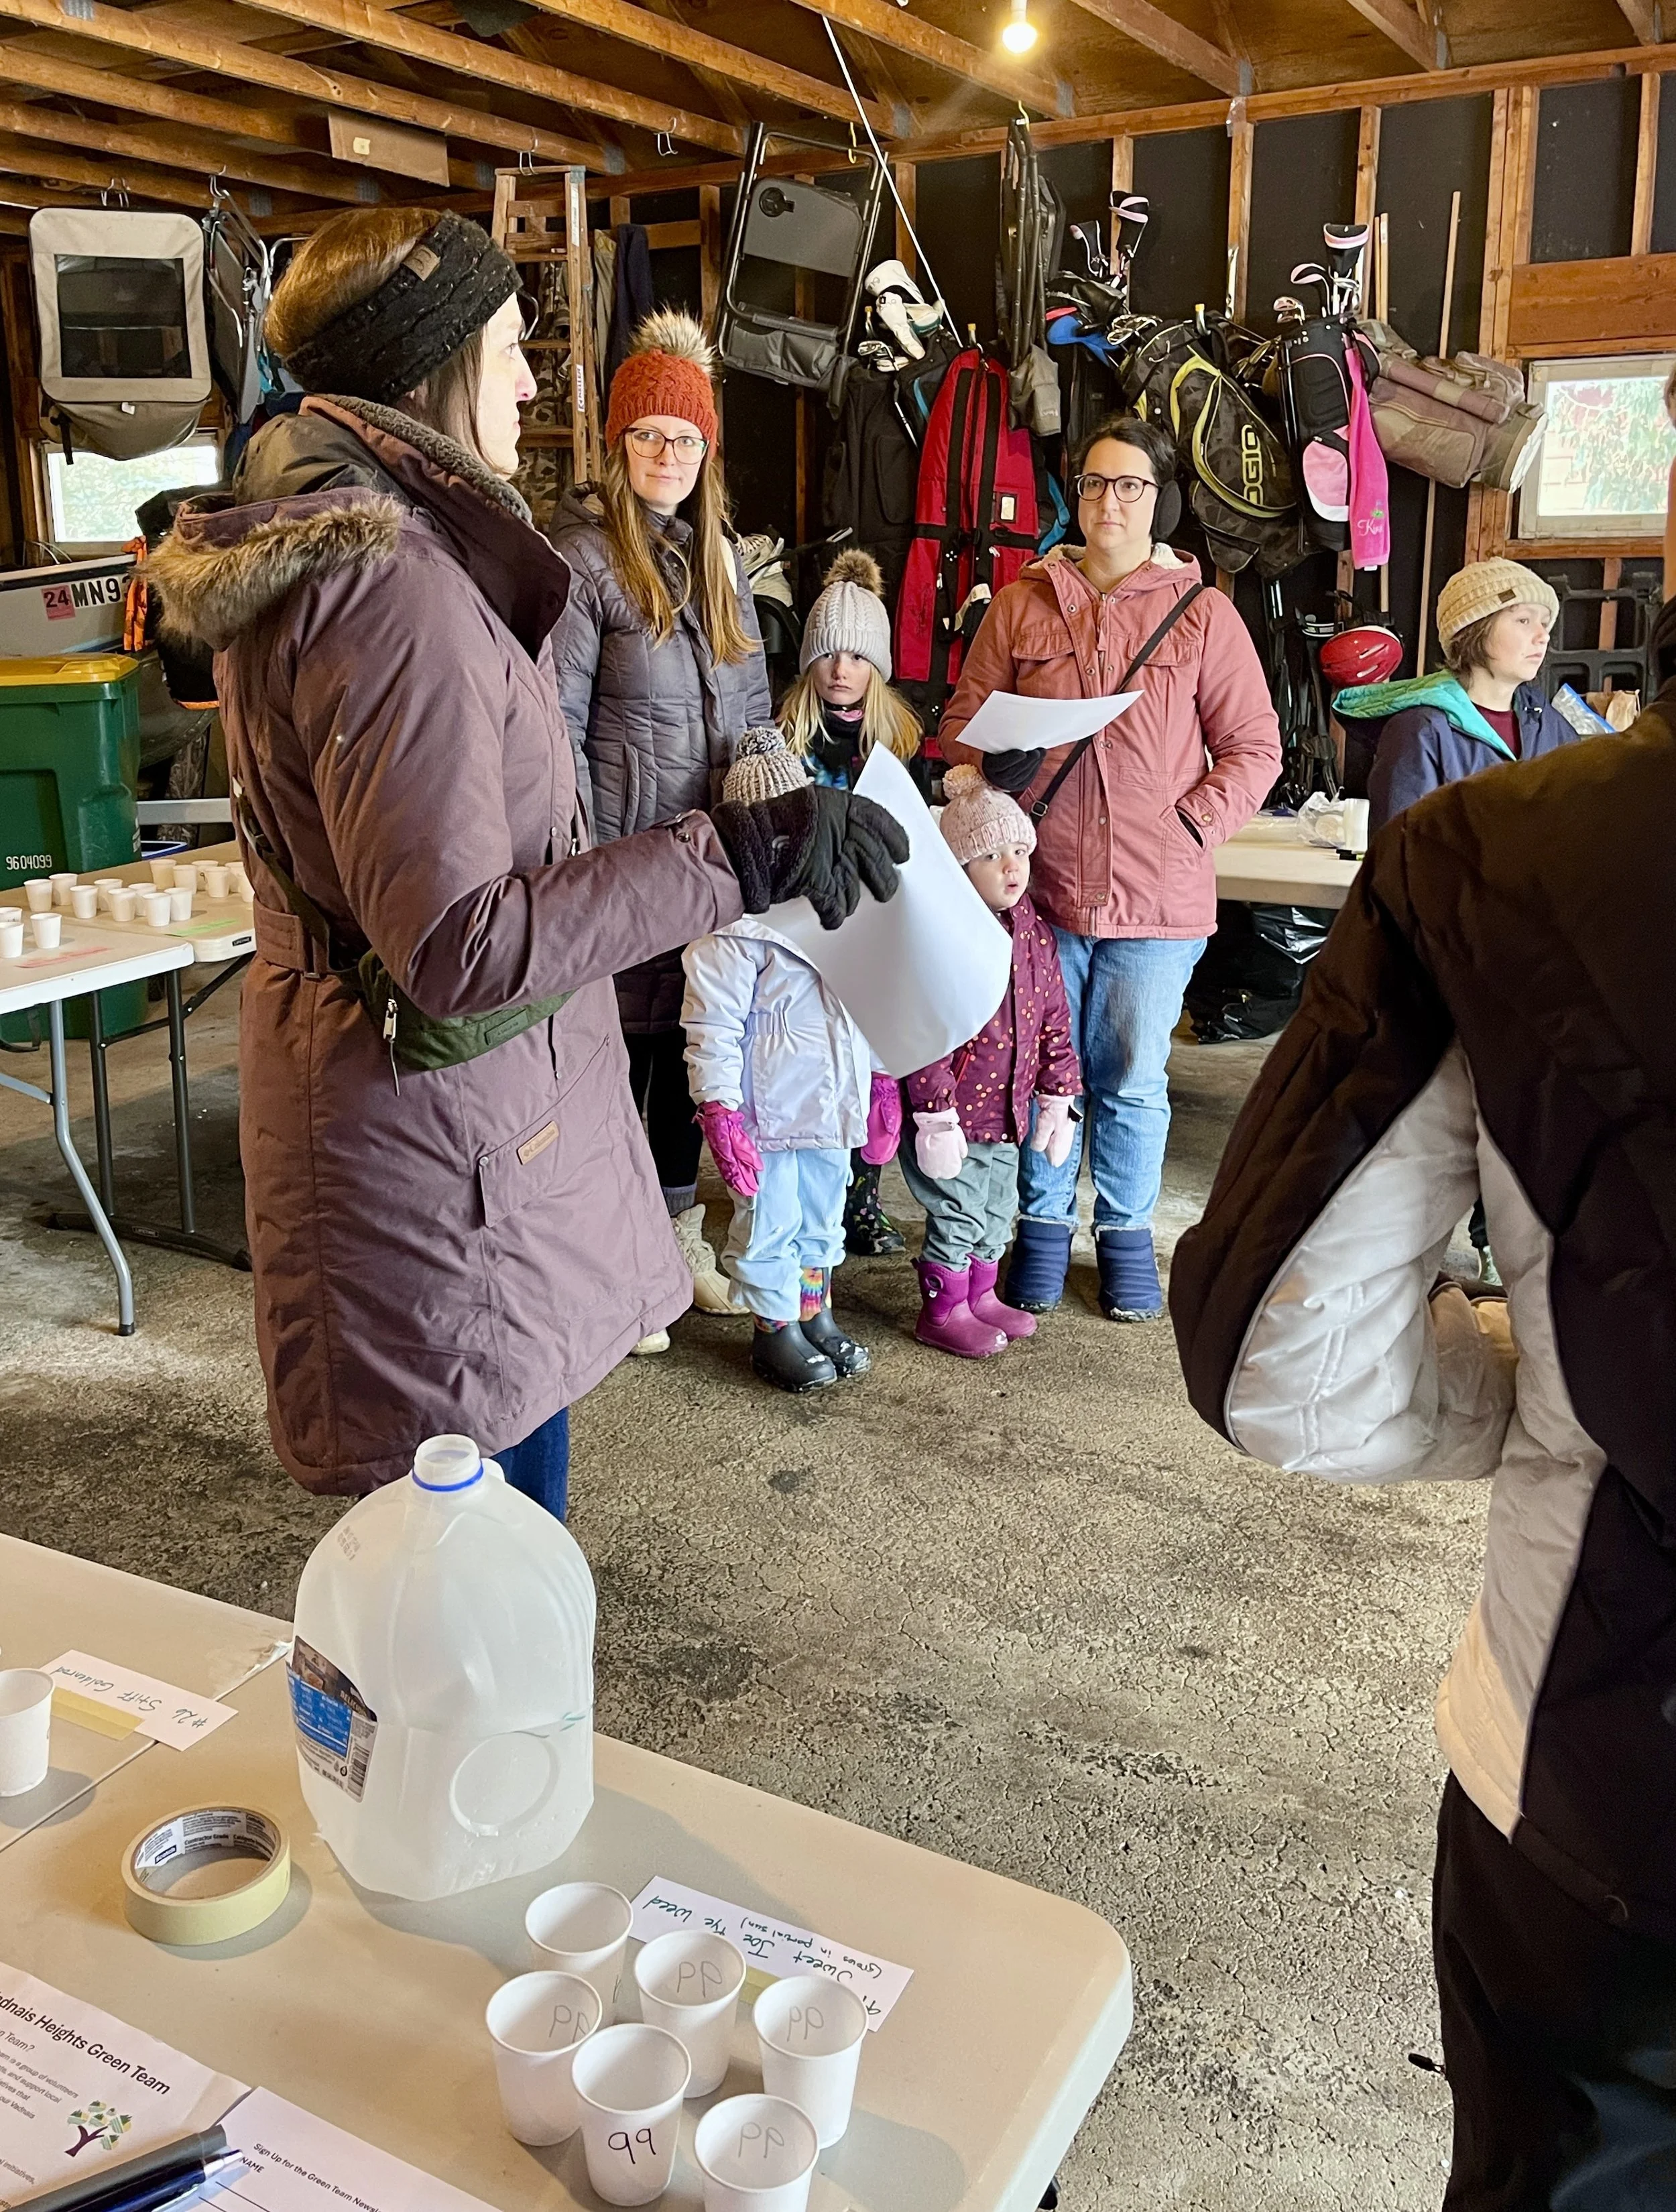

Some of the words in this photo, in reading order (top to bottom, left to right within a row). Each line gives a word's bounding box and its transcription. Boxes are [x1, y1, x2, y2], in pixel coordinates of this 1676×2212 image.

[1242, 424, 1264, 505] OGIO
[44, 589, 70, 608] 24
[5, 855, 52, 871] 9604099
[642, 1896, 693, 1922] Weed
[743, 1934, 775, 1959] Joe
[821, 1947, 832, 1959] in
[0, 1995, 36, 2022] dnais
[34, 2015, 88, 2050] Heights
[86, 2044, 131, 2074] Green
[131, 2064, 172, 2096] Team
[5, 2032, 35, 2052] Team?
[19, 2065, 40, 2077] group
[46, 2077, 79, 2099] volunteers
[20, 2078, 46, 2095] support
[44, 2091, 62, 2104] local
[607, 2128, 656, 2164] 99
[241, 2156, 265, 2174] NAME
[253, 2143, 271, 2157] Sign
[270, 2152, 283, 2164] Up
[282, 2159, 295, 2170] for
[294, 2165, 308, 2177] the
[307, 2173, 331, 2190] Green
[332, 2185, 353, 2201] Team
[352, 2197, 381, 2212] Newsl
